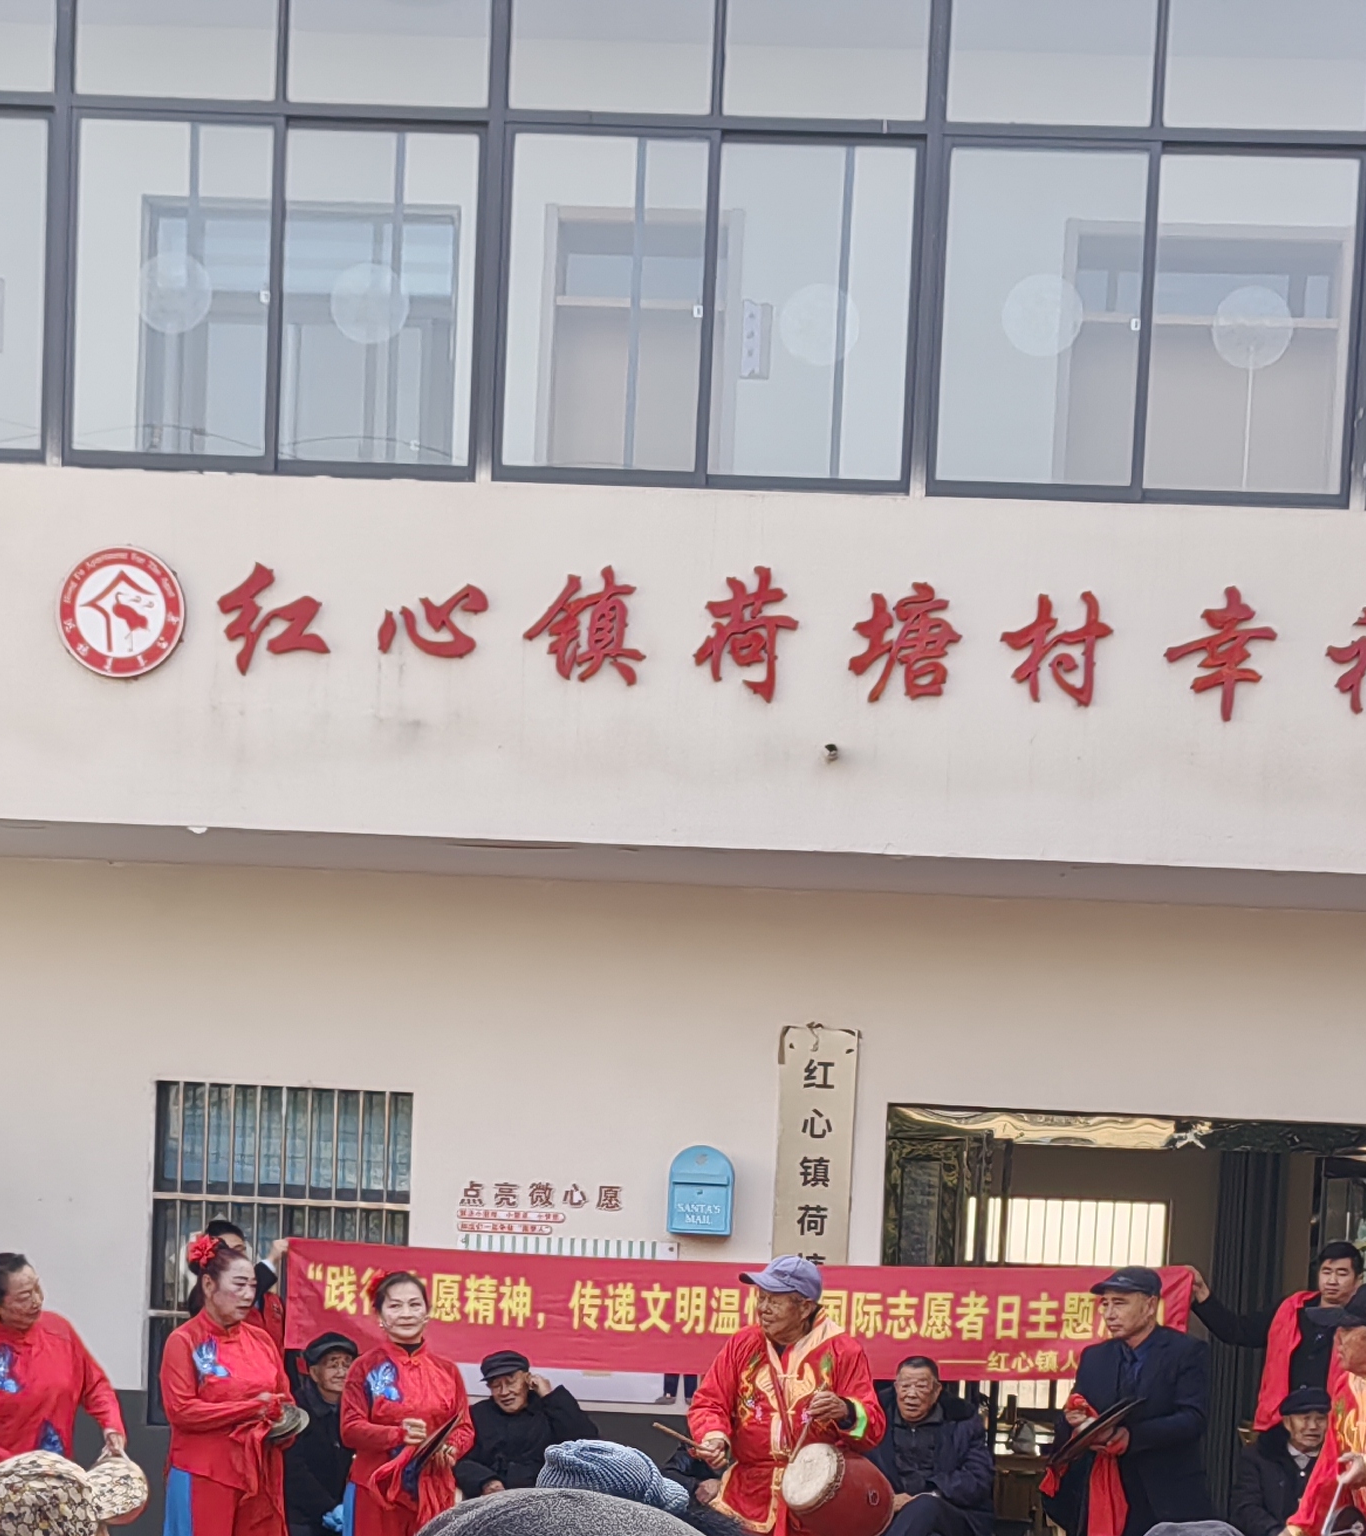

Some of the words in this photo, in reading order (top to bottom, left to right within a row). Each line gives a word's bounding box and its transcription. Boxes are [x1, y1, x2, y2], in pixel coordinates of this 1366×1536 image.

[458, 1179, 624, 1212] 点亮微心愿
[685, 1213, 712, 1225] MAIL
